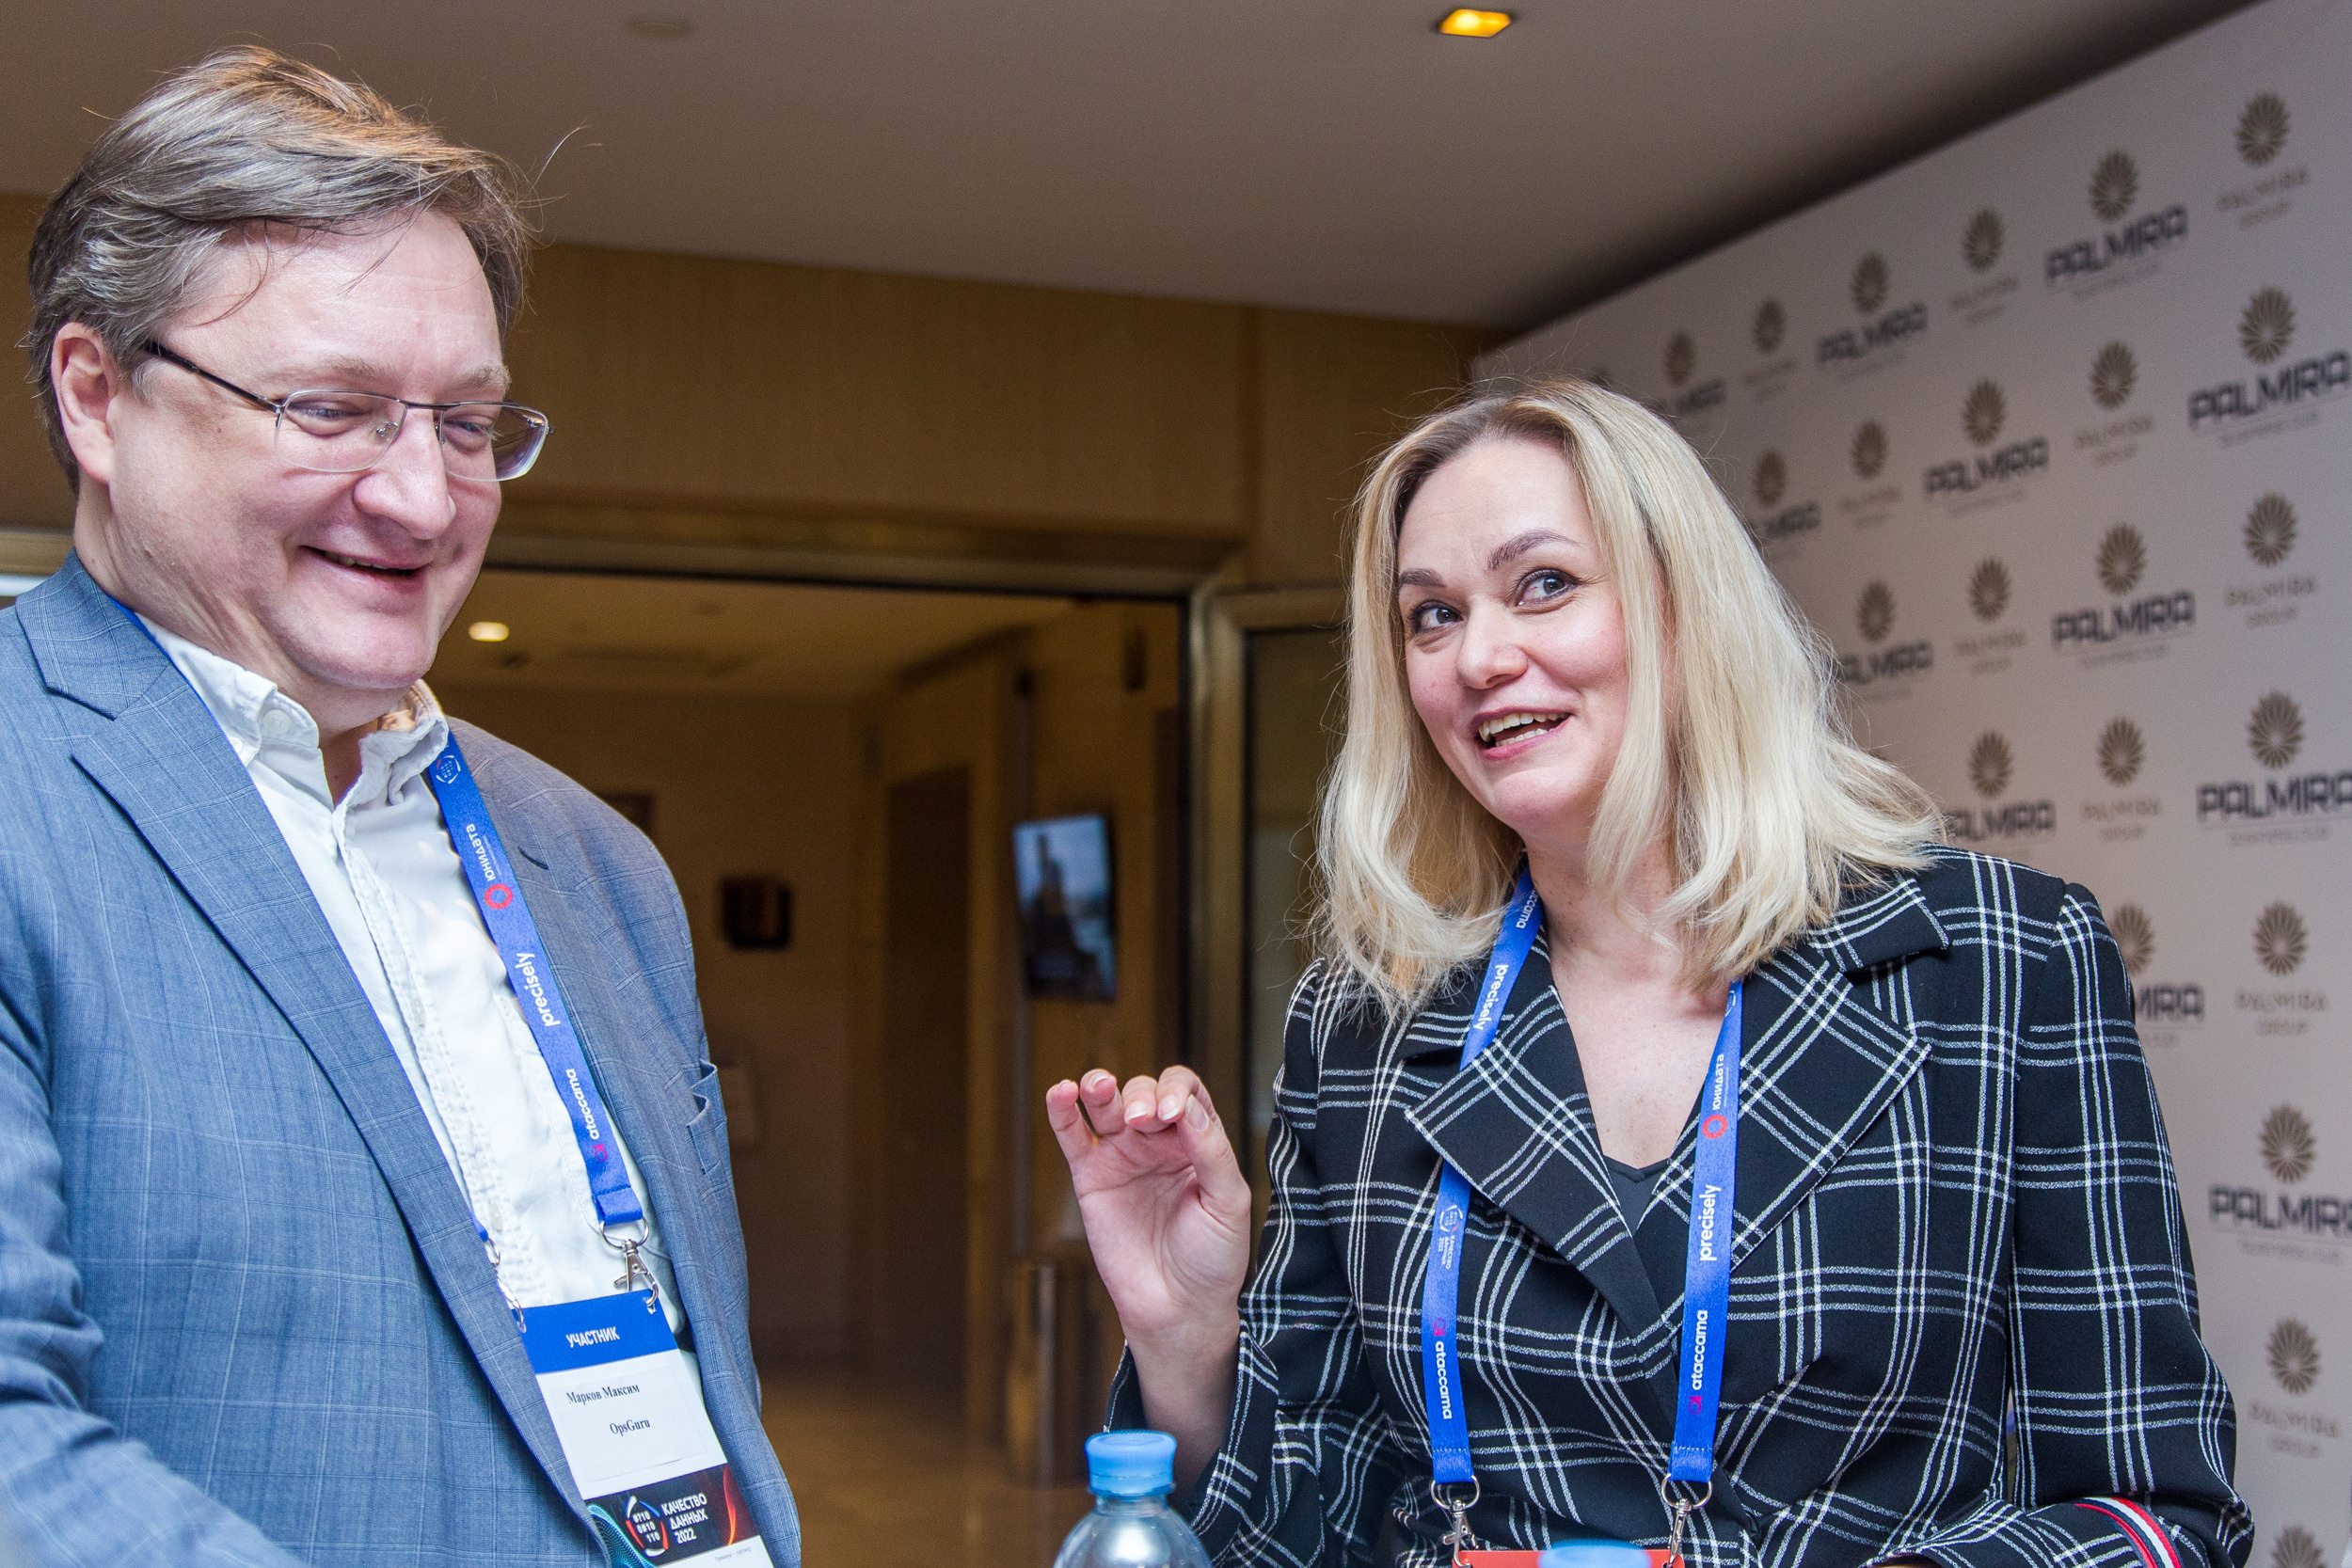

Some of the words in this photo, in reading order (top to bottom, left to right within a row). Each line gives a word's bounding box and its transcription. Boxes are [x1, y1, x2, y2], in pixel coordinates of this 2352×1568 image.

[2043, 204, 2189, 281] PALMIRA
[2188, 351, 2351, 432] PALMIRA
[2052, 590, 2195, 652] PALMIRA
[2196, 770, 2352, 823] PALMIRA
[516, 951, 561, 1028] precisely
[1472, 963, 1509, 1031] precisely
[565, 1068, 601, 1141] ataccama
[1699, 1182, 1722, 1263] precisely
[565, 1326, 621, 1349] УЧАСТНИК
[1692, 1308, 1709, 1391] ataccama
[566, 1389, 602, 1405] Марков
[602, 1383, 641, 1400] Максим
[1433, 1339, 1453, 1421] ataccama
[610, 1418, 651, 1437] OpsGuru
[660, 1492, 707, 1516] КАЧЕСТВО
[669, 1508, 708, 1530] ДАННЫХ
[674, 1527, 697, 1544] 2022
